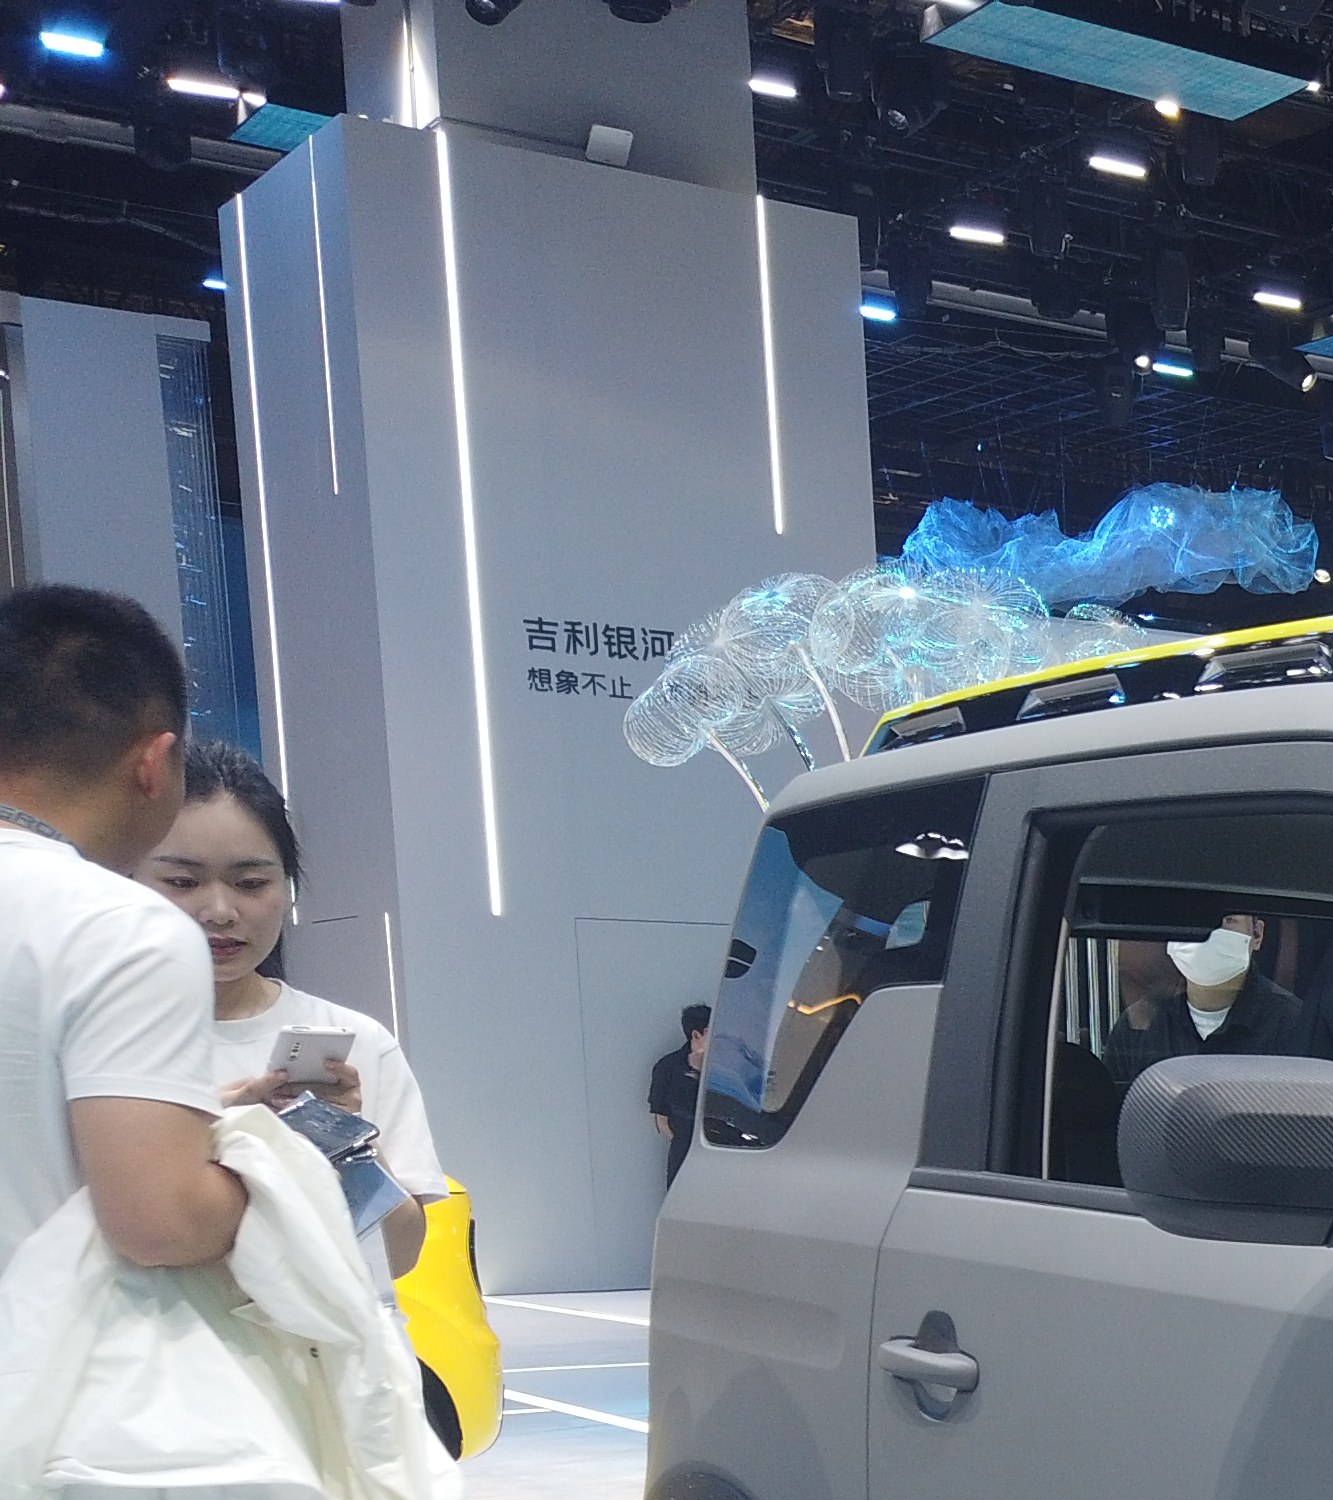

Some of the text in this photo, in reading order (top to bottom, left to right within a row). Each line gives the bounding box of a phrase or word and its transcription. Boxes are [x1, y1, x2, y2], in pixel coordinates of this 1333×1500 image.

[523, 617, 675, 662] 吉利银河
[527, 667, 633, 699] 想象不止
